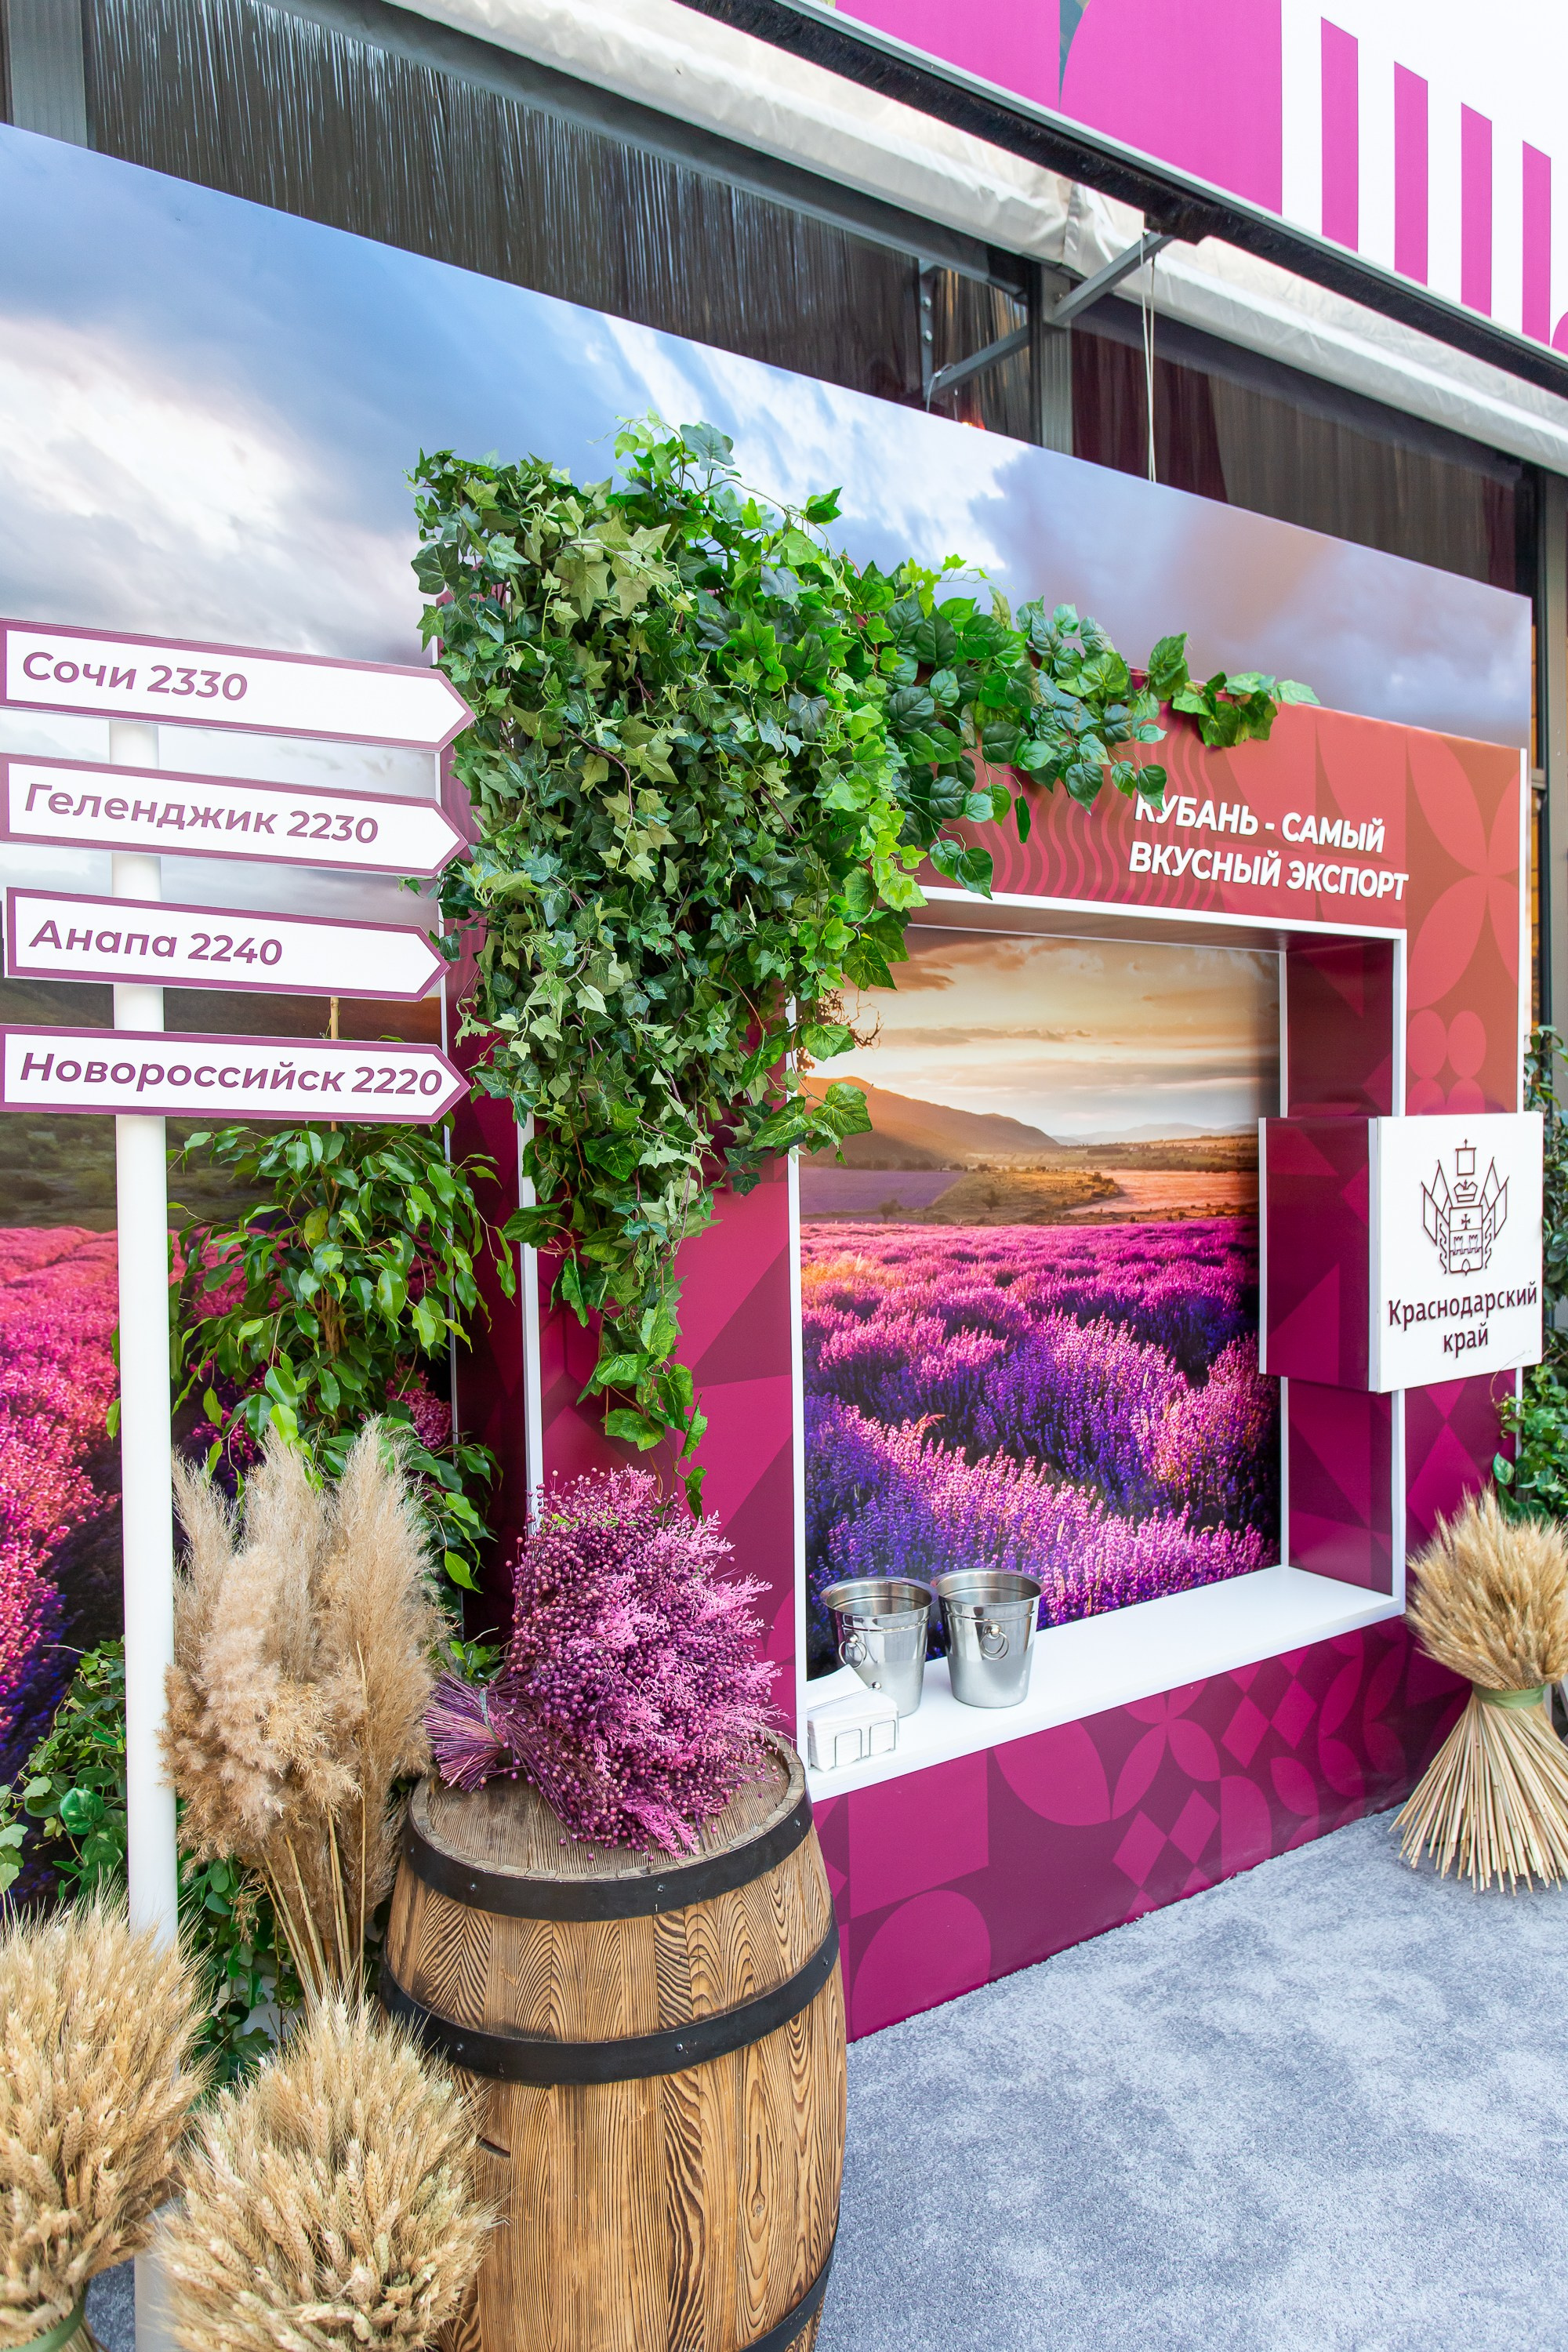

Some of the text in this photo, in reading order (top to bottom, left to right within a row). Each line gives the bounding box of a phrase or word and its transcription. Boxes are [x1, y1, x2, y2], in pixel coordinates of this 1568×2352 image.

[23, 652, 248, 701] Сочи 2330
[24, 782, 379, 844] Геленджик 2230
[1134, 793, 1258, 836] КУБАНЬ
[1282, 812, 1385, 853] САМЫЙ
[1129, 840, 1410, 901] ВКУСНЫЙ ЭКСПОРТ
[27, 920, 283, 966] Анапа 2240
[20, 1052, 443, 1096] Новороссийск 2220
[1388, 1280, 1537, 1332] Краснодарский
[1443, 1321, 1489, 1359] край
